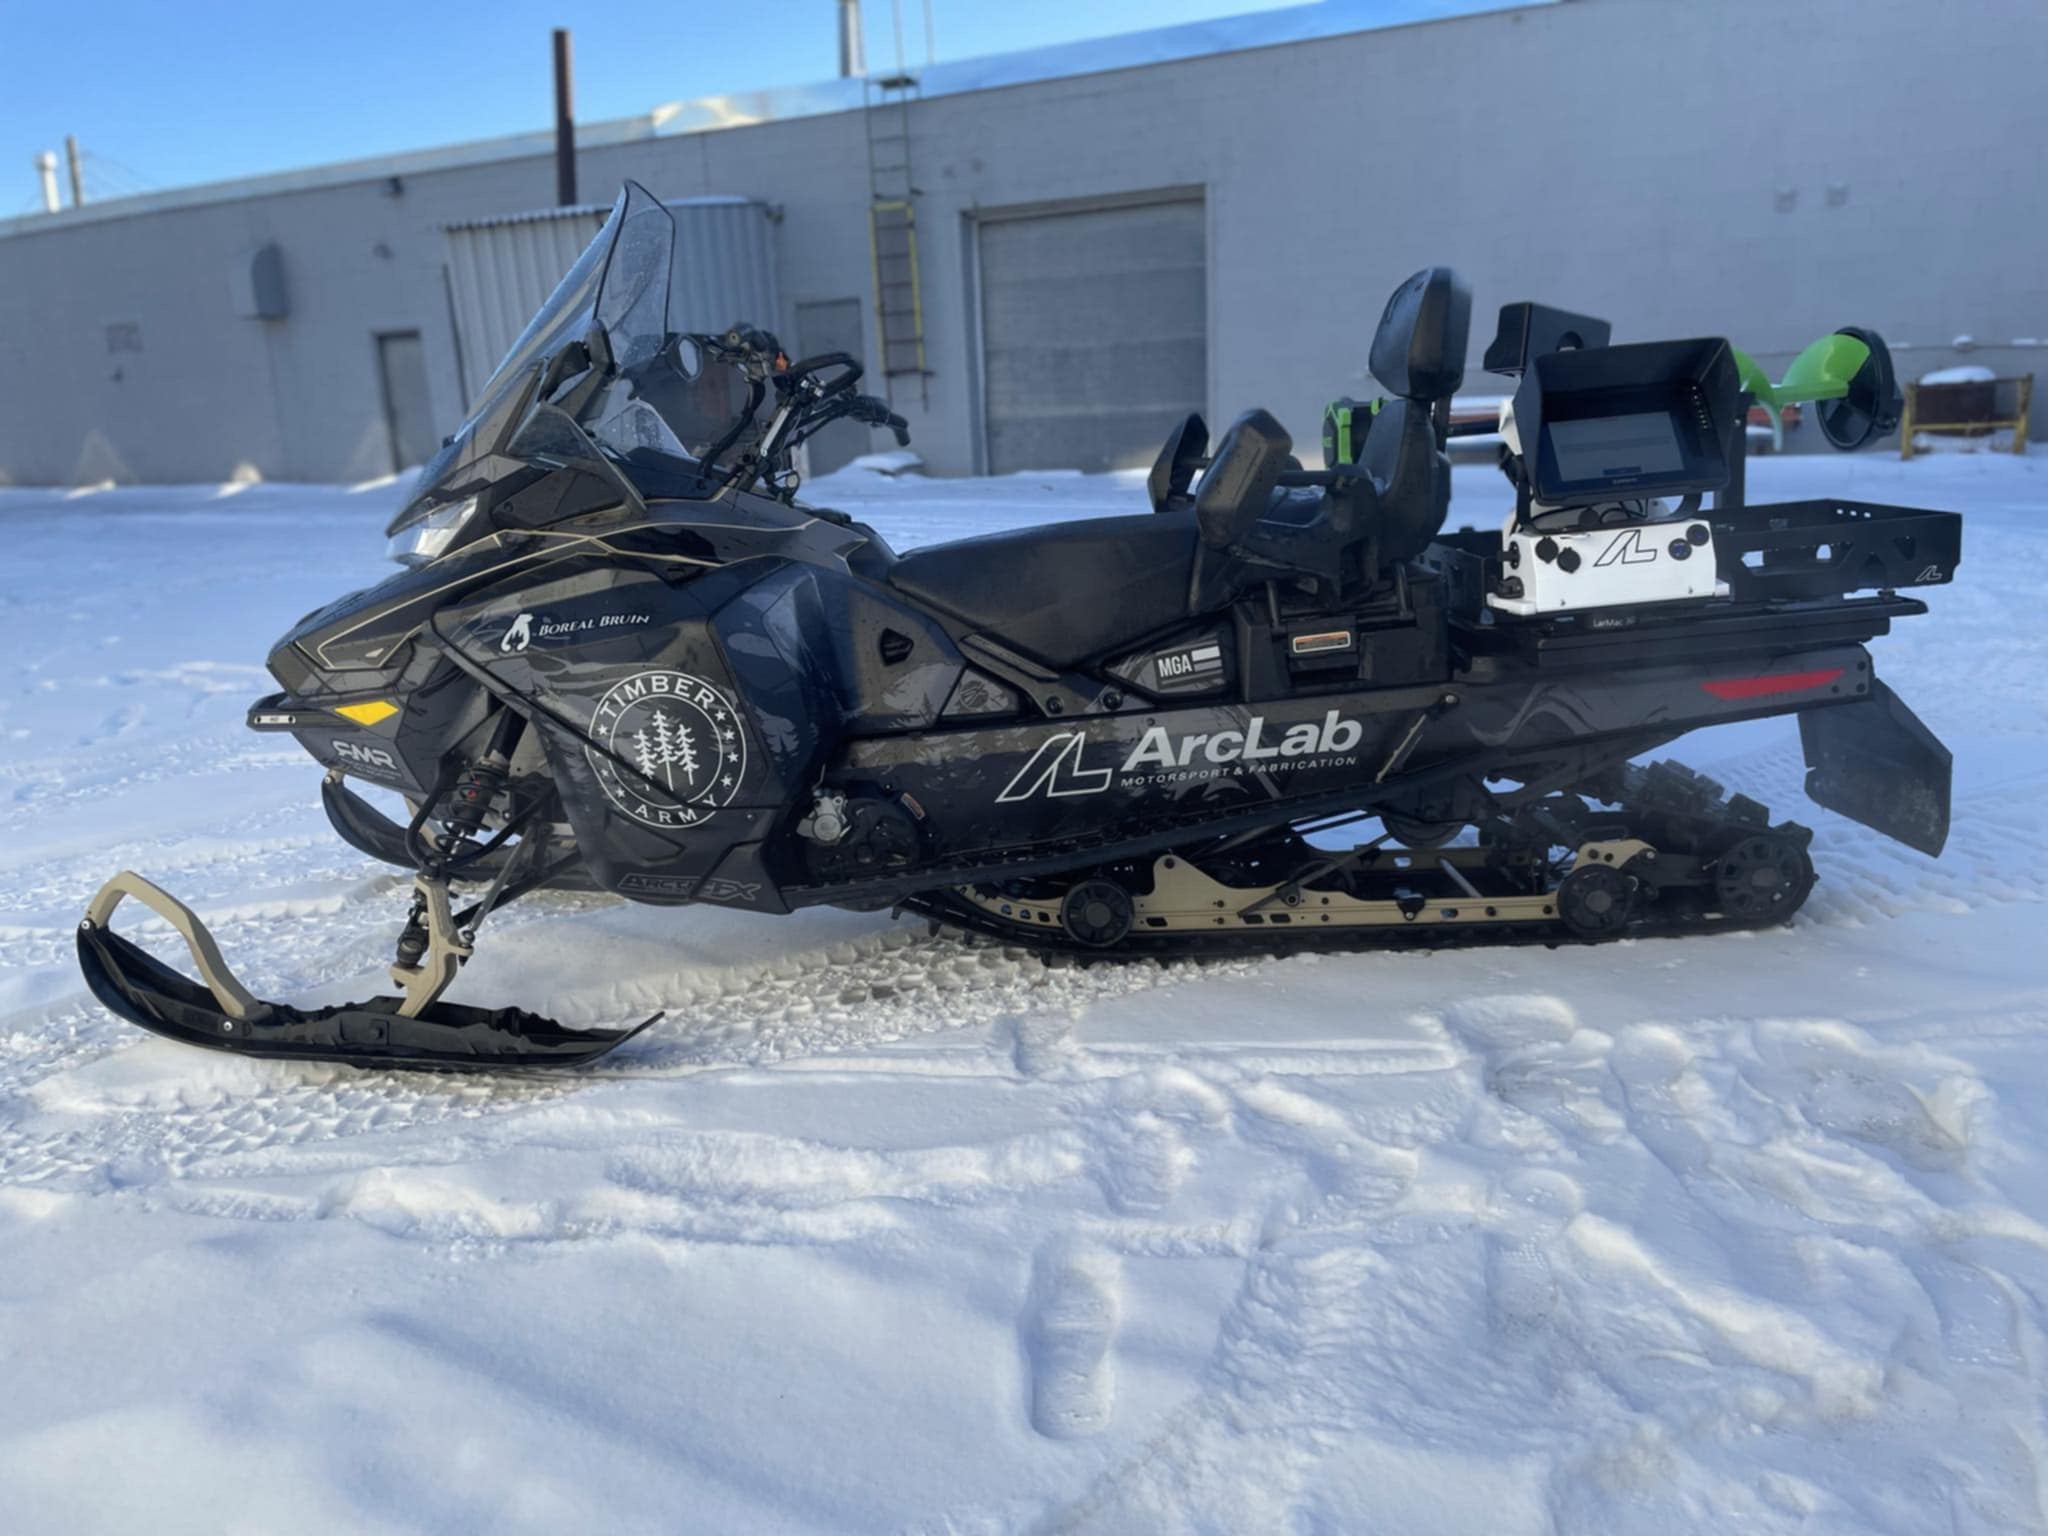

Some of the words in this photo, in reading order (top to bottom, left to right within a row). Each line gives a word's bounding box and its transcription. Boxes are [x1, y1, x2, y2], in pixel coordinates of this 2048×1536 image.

[538, 618, 595, 637] BOREAL
[599, 614, 650, 628] BRUIN
[1157, 653, 1193, 678] MGA
[599, 675, 716, 719] TIMBER
[1120, 709, 1363, 773] ArcLab
[1120, 766, 1231, 788] MOTORSPORT
[1233, 766, 1244, 777] &
[1248, 756, 1358, 774] FABRICATION
[634, 793, 719, 825] ARMY
